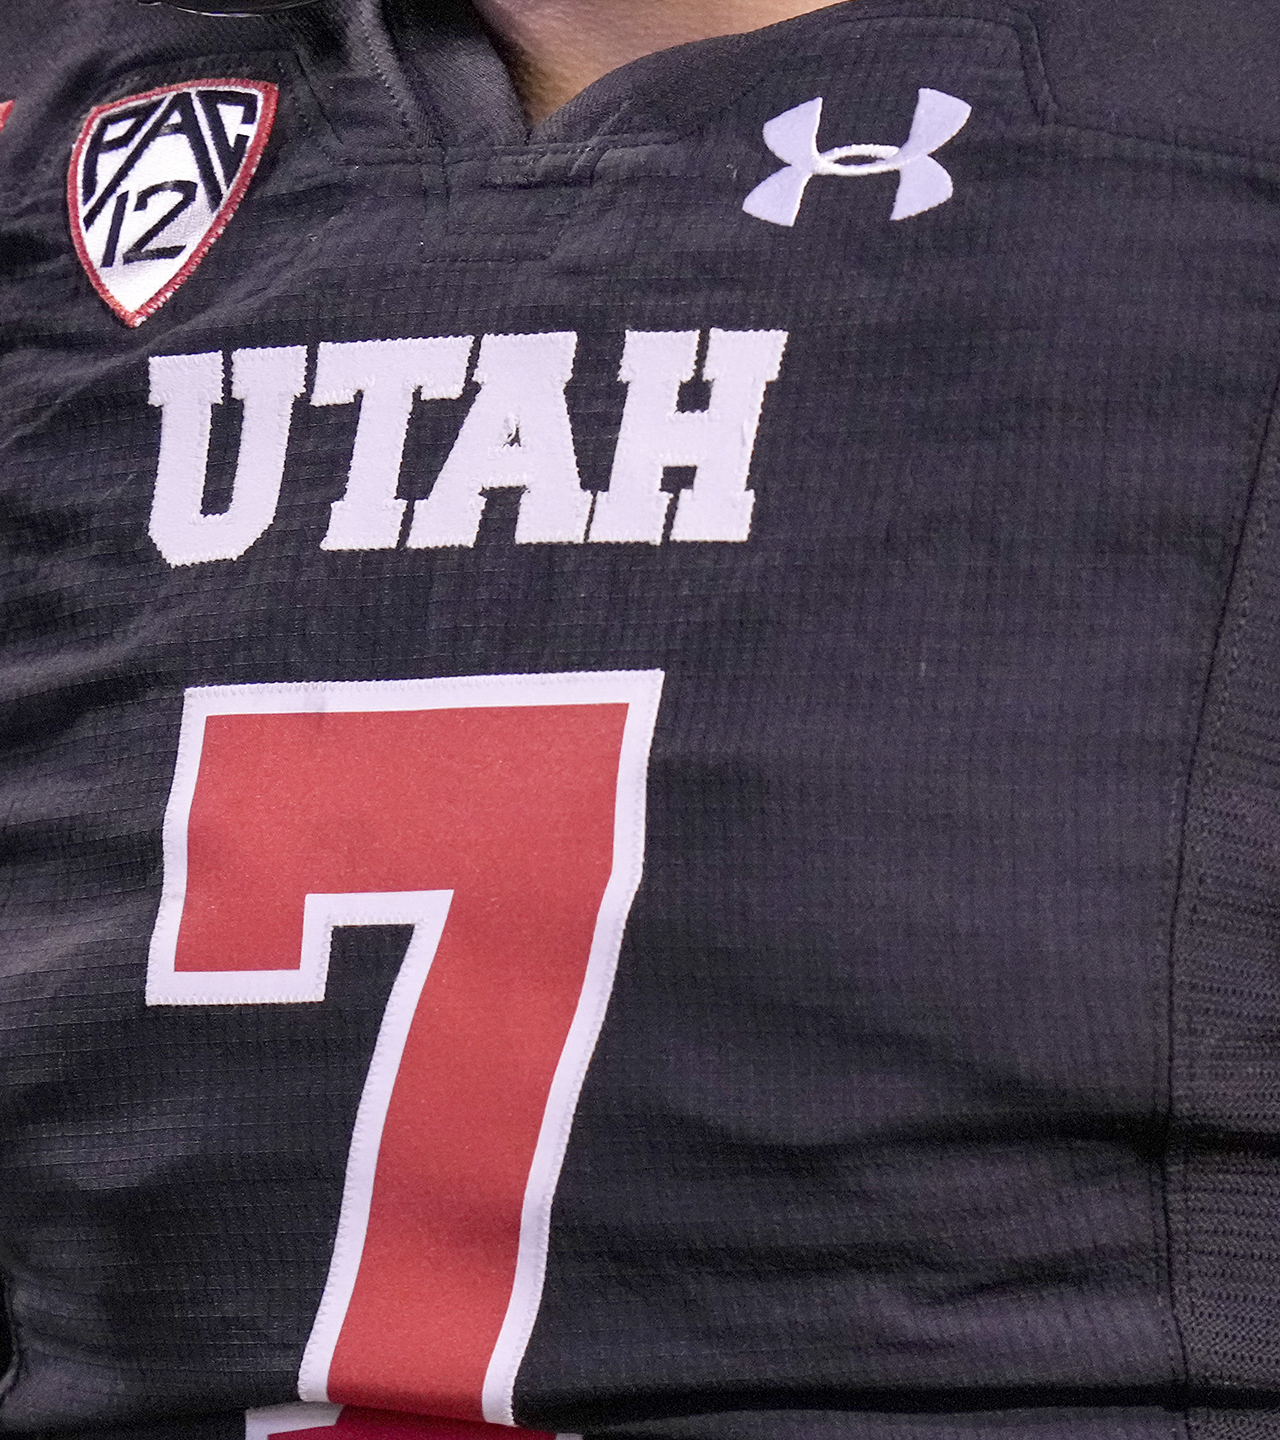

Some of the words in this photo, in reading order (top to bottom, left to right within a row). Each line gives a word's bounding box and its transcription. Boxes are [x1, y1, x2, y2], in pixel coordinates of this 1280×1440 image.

[82, 89, 259, 232] PAC
[100, 180, 198, 267] 12
[147, 326, 789, 568] UTAH
[145, 669, 665, 1440] 7
